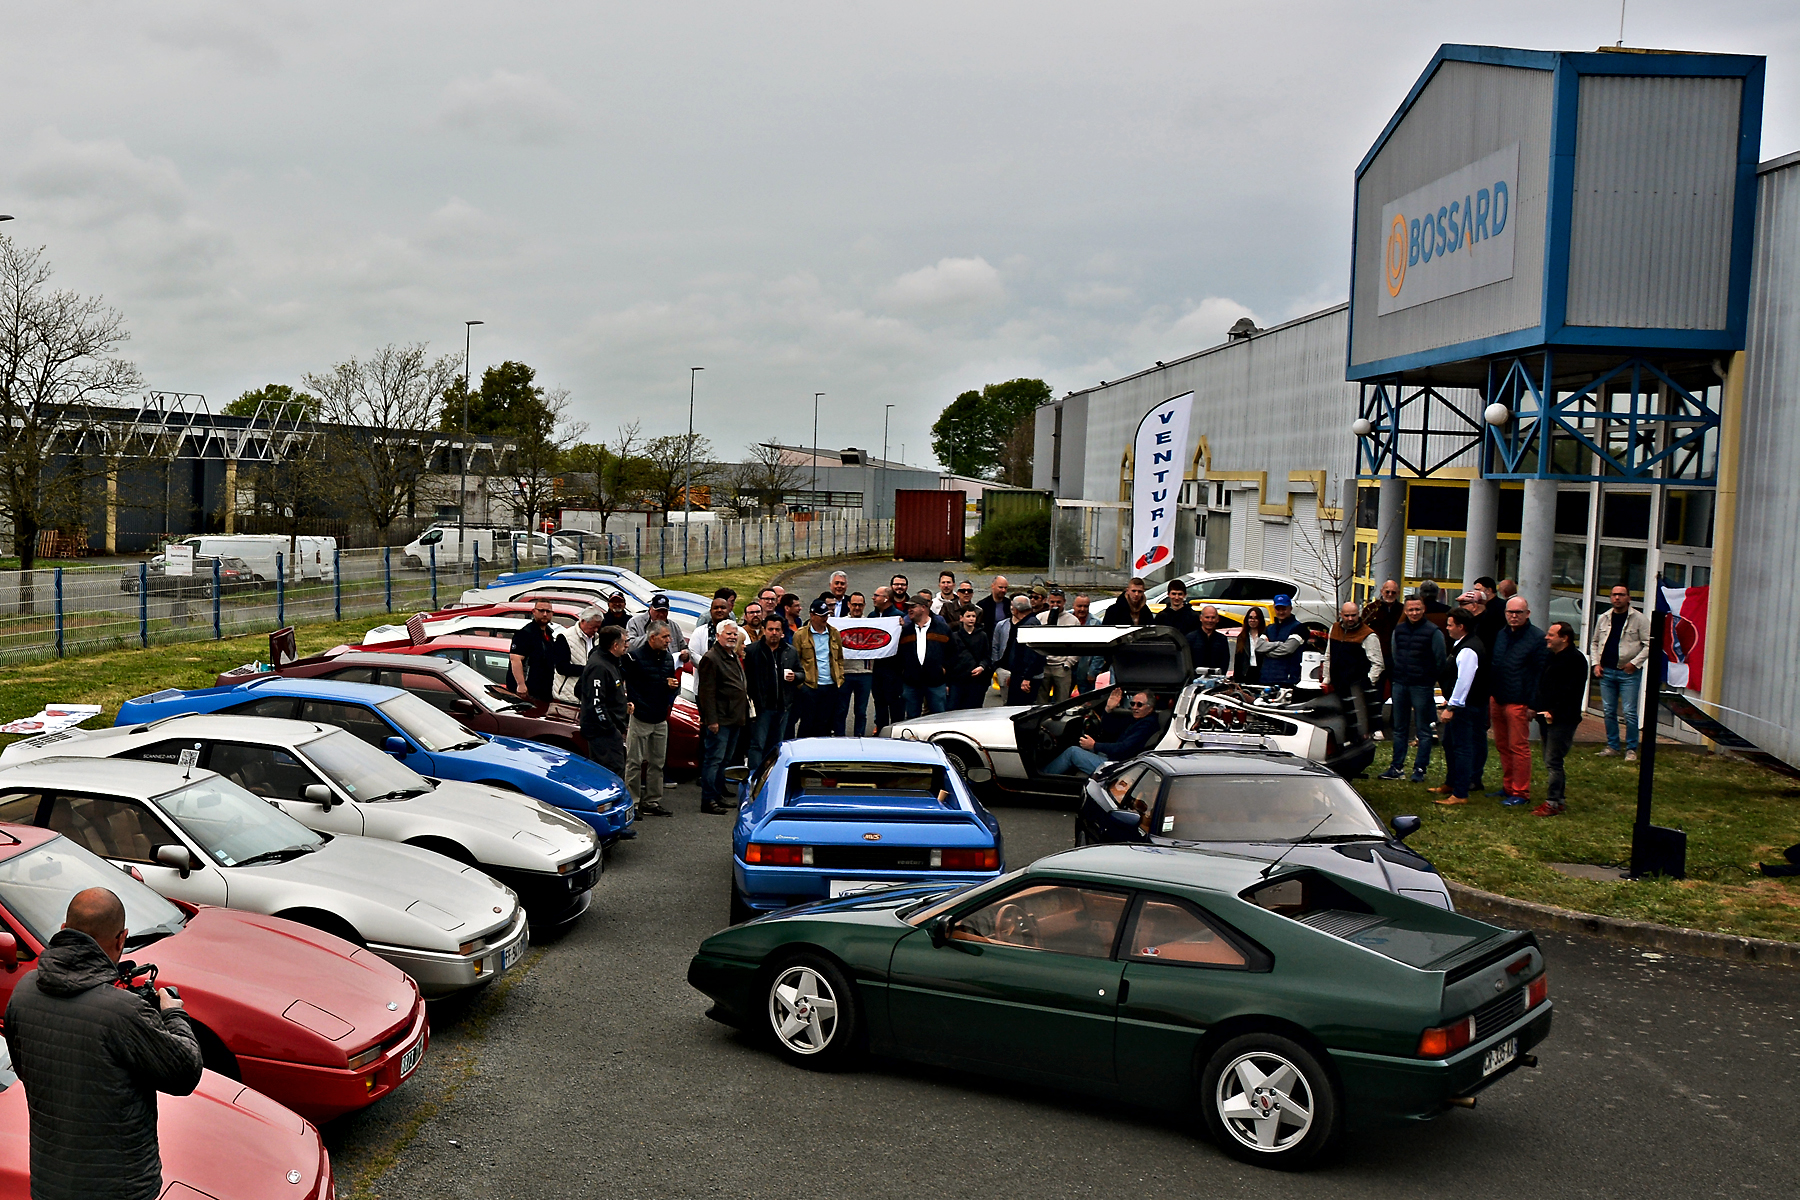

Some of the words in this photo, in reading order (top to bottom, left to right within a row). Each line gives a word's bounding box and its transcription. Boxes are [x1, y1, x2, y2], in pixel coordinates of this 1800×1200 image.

[1408, 180, 1509, 268] BOSSARD
[1150, 410, 1175, 538] VENTURI
[841, 632, 887, 646] MVS
